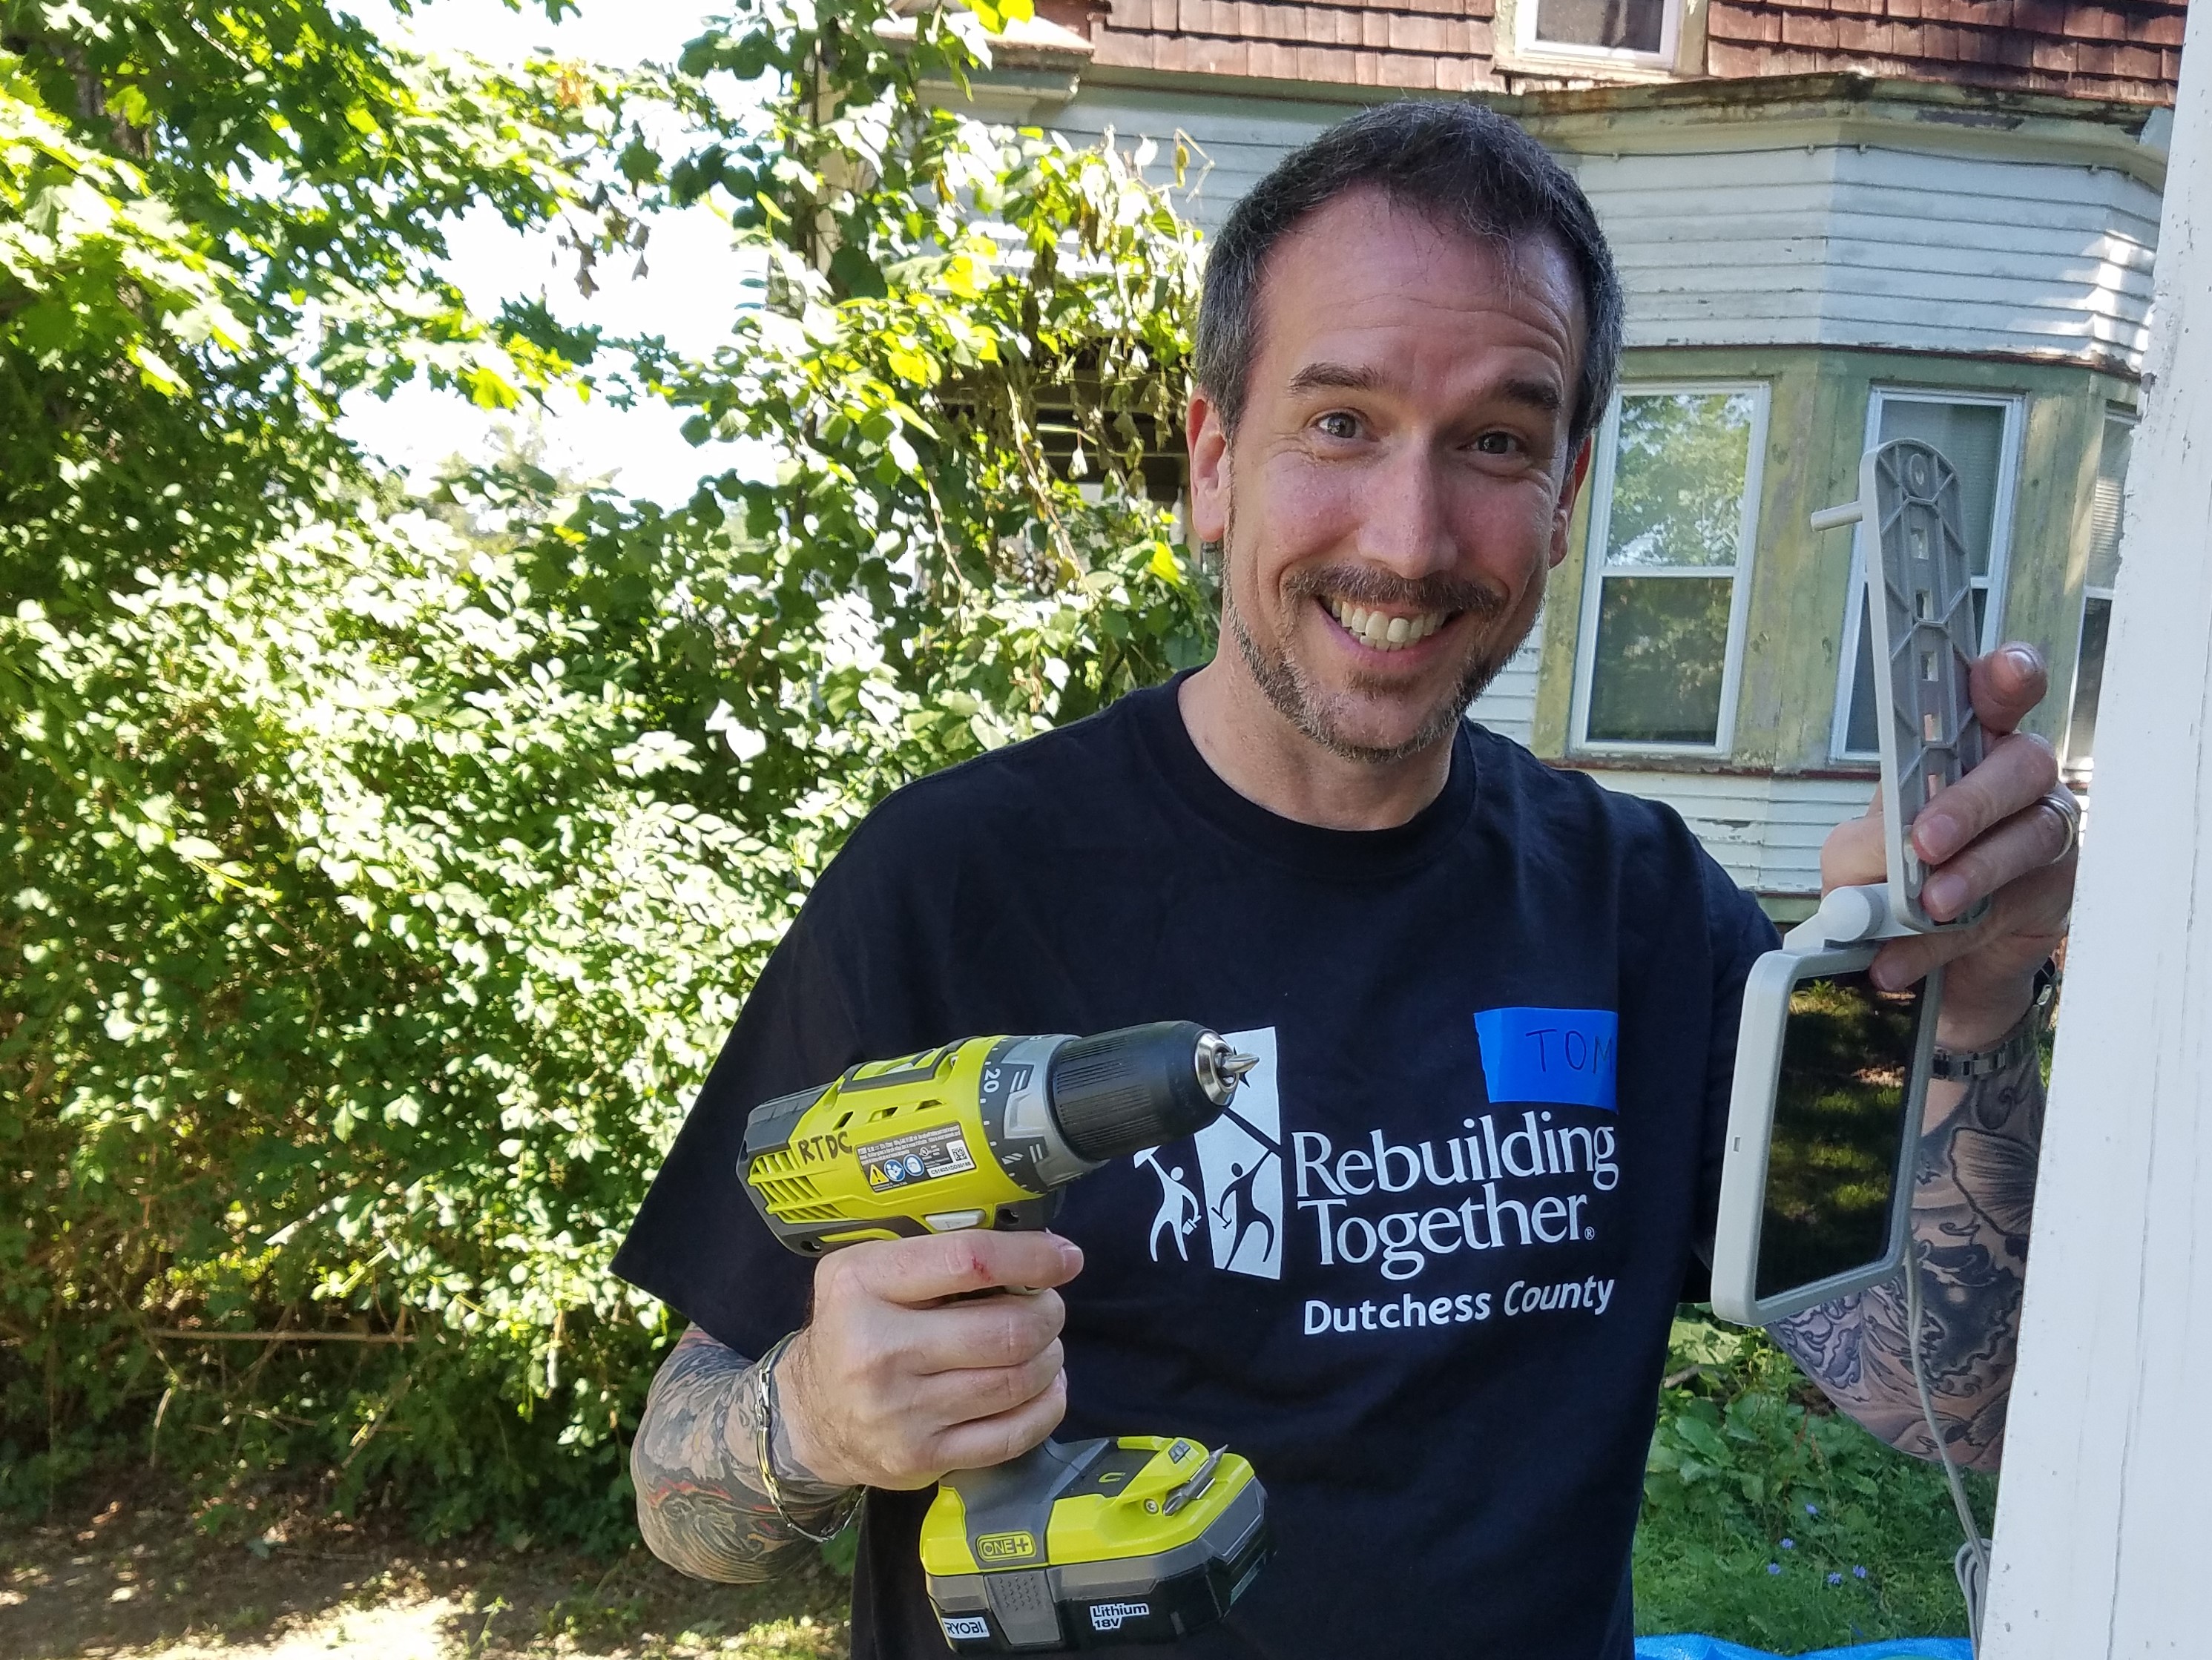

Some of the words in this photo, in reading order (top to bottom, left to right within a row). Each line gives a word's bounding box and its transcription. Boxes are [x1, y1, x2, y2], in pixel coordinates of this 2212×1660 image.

[1525, 1028, 1613, 1074] TOM
[983, 1068, 1001, 1093] 20
[797, 1131, 853, 1165] RTDC
[1291, 1110, 1619, 1197] Rebuilding
[1304, 1292, 1492, 1335] Dutchess
[1504, 1275, 1616, 1317] County
[982, 1537, 1030, 1556] ONE+
[1093, 1604, 1148, 1618] Lithium
[1094, 1618, 1119, 1628] 18V
[944, 1621, 984, 1635] RYOBI
